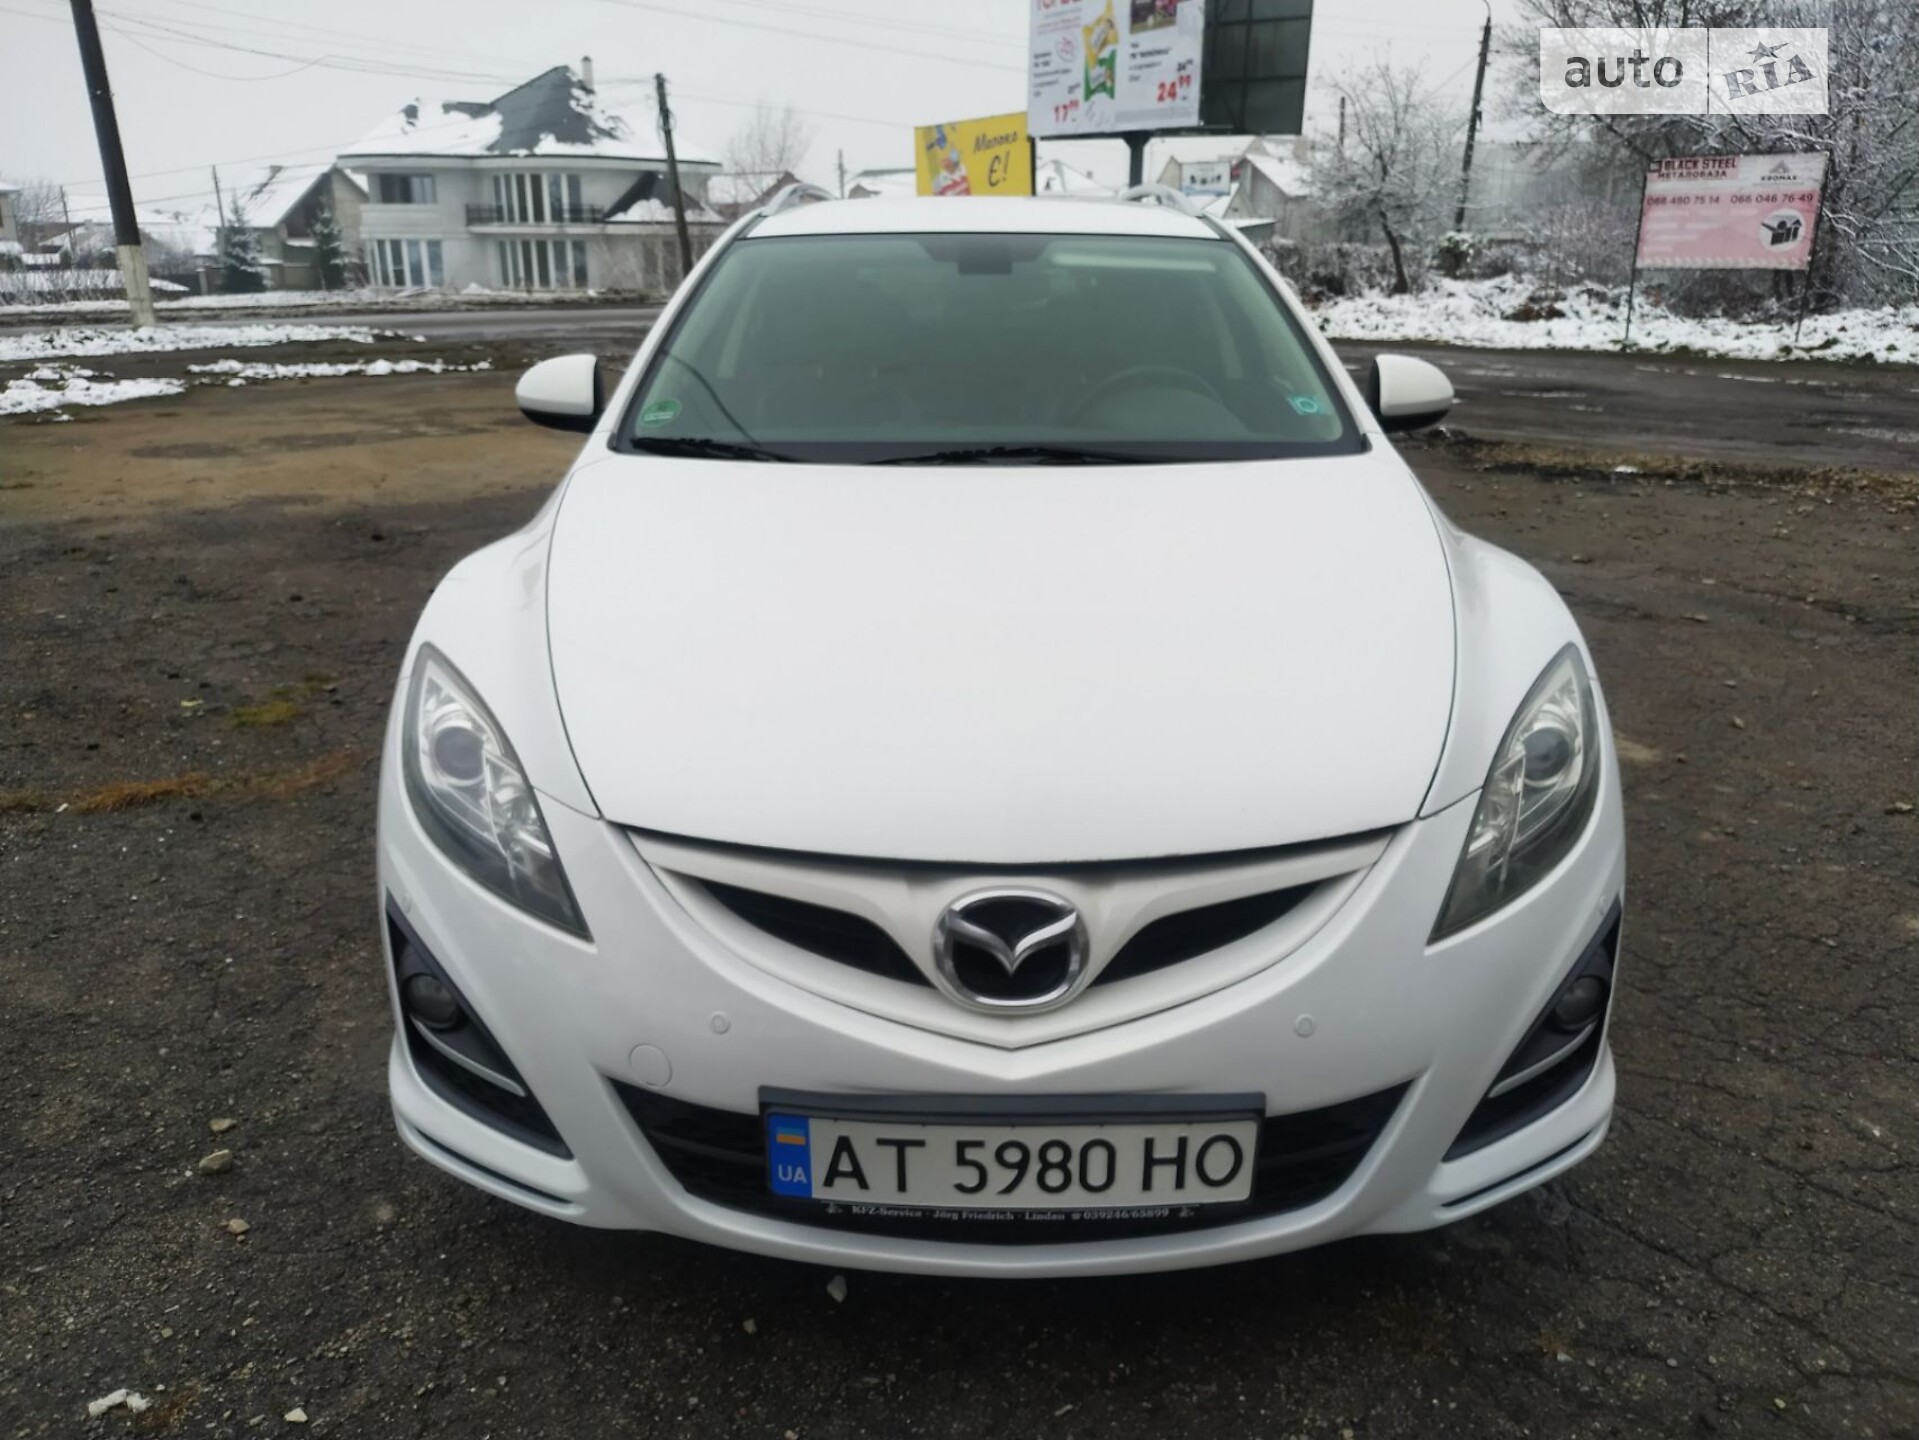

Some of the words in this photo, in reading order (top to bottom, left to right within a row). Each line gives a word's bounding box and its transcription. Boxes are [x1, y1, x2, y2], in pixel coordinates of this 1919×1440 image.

[1664, 158, 1699, 171] BLACK
[1702, 157, 1737, 170] STEEL
[1755, 193, 1778, 203] 046
[1799, 192, 1814, 203] 49
[822, 1134, 926, 1194] AT
[953, 1138, 1117, 1195] 5980
[1141, 1133, 1244, 1192] HO
[777, 1164, 808, 1185] UA
[961, 1209, 1015, 1221] Friedrich
[1025, 1210, 1066, 1221] Lindau
